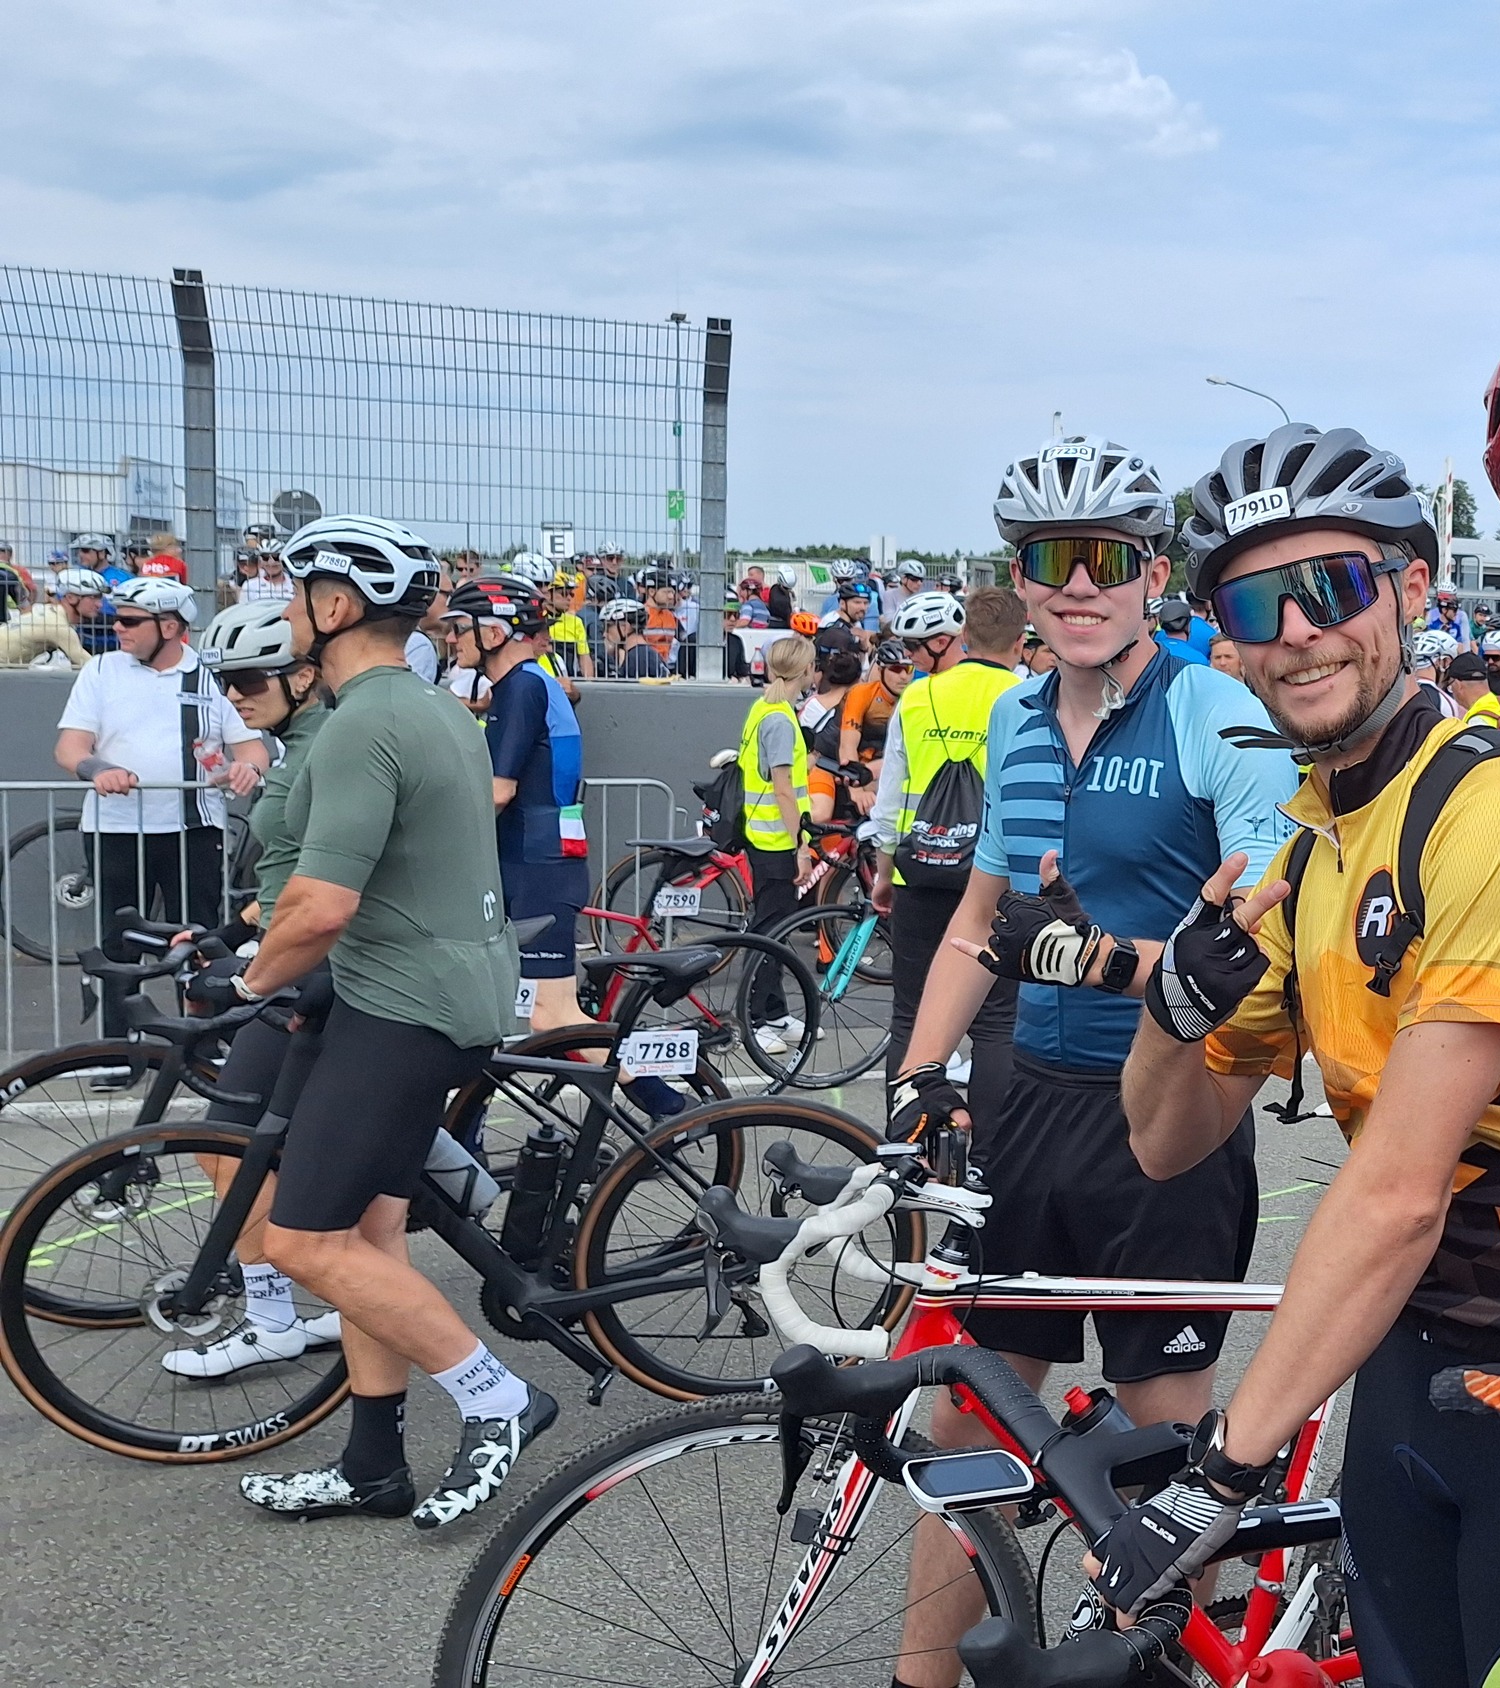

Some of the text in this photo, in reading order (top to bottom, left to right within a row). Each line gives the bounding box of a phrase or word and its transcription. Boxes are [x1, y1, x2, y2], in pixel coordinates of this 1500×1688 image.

[1229, 494, 1283, 525] 7791D
[550, 535, 564, 553] E
[318, 554, 347, 568] 7788D
[665, 894, 696, 907] 7590
[627, 1042, 690, 1065] D 7788
[1163, 1341, 1206, 1354] adidas
[178, 1412, 290, 1453] DT SWISS
[765, 1487, 843, 1659] STEVENS
